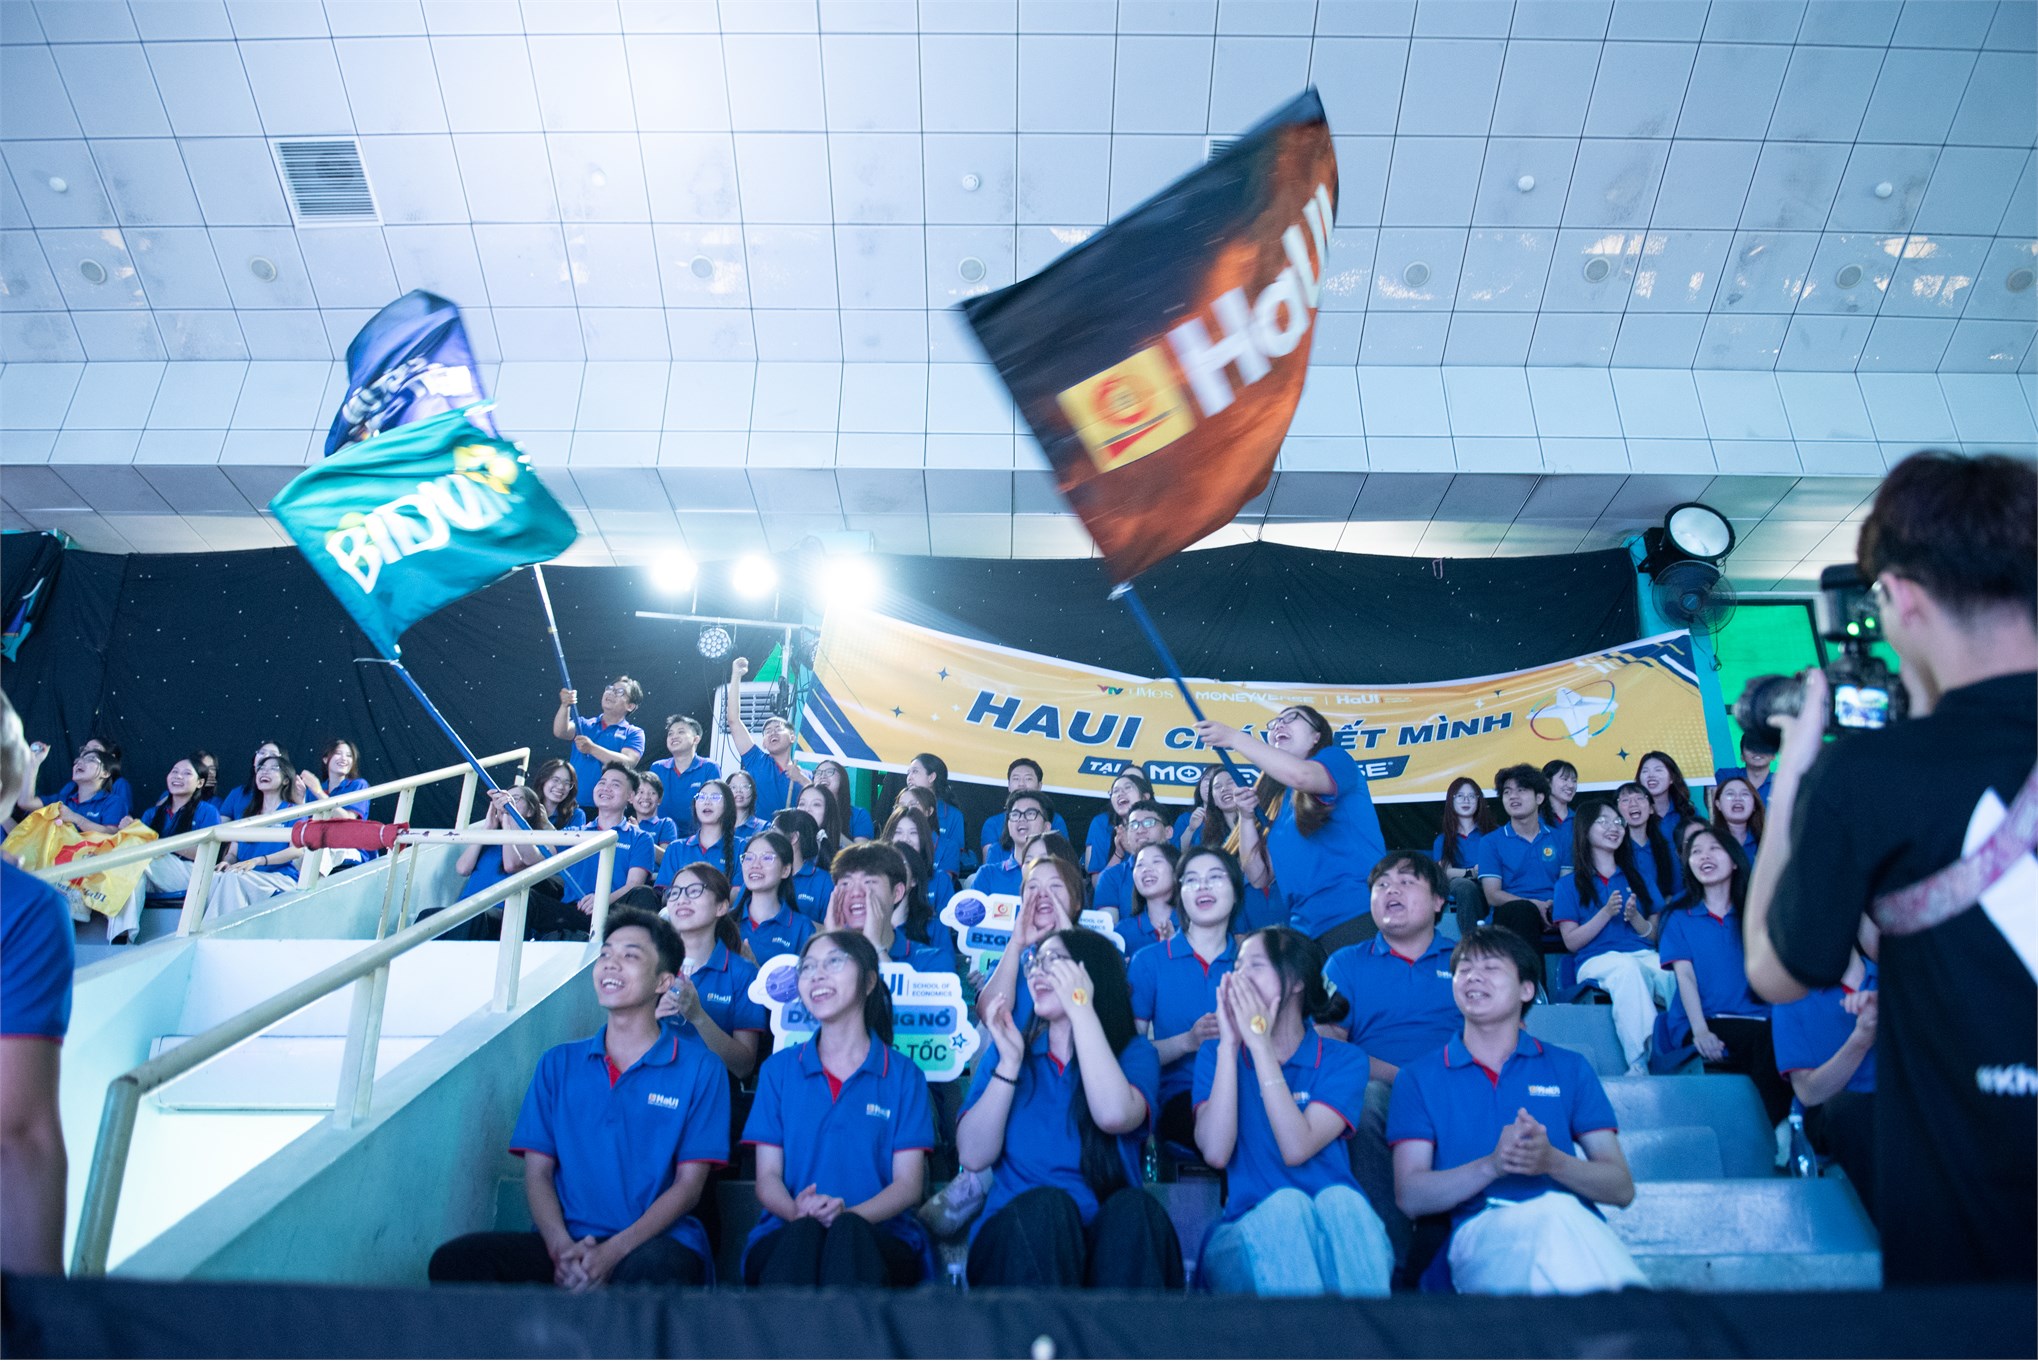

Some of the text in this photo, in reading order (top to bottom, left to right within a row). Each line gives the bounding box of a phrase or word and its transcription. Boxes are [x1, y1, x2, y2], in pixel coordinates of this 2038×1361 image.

[964, 689, 1143, 750] HAUI
[1397, 711, 1512, 746] MÌNH
[1089, 761, 1122, 774] TẠI
[907, 1038, 947, 1061] TỐC
[656, 1093, 679, 1108] HaUI
